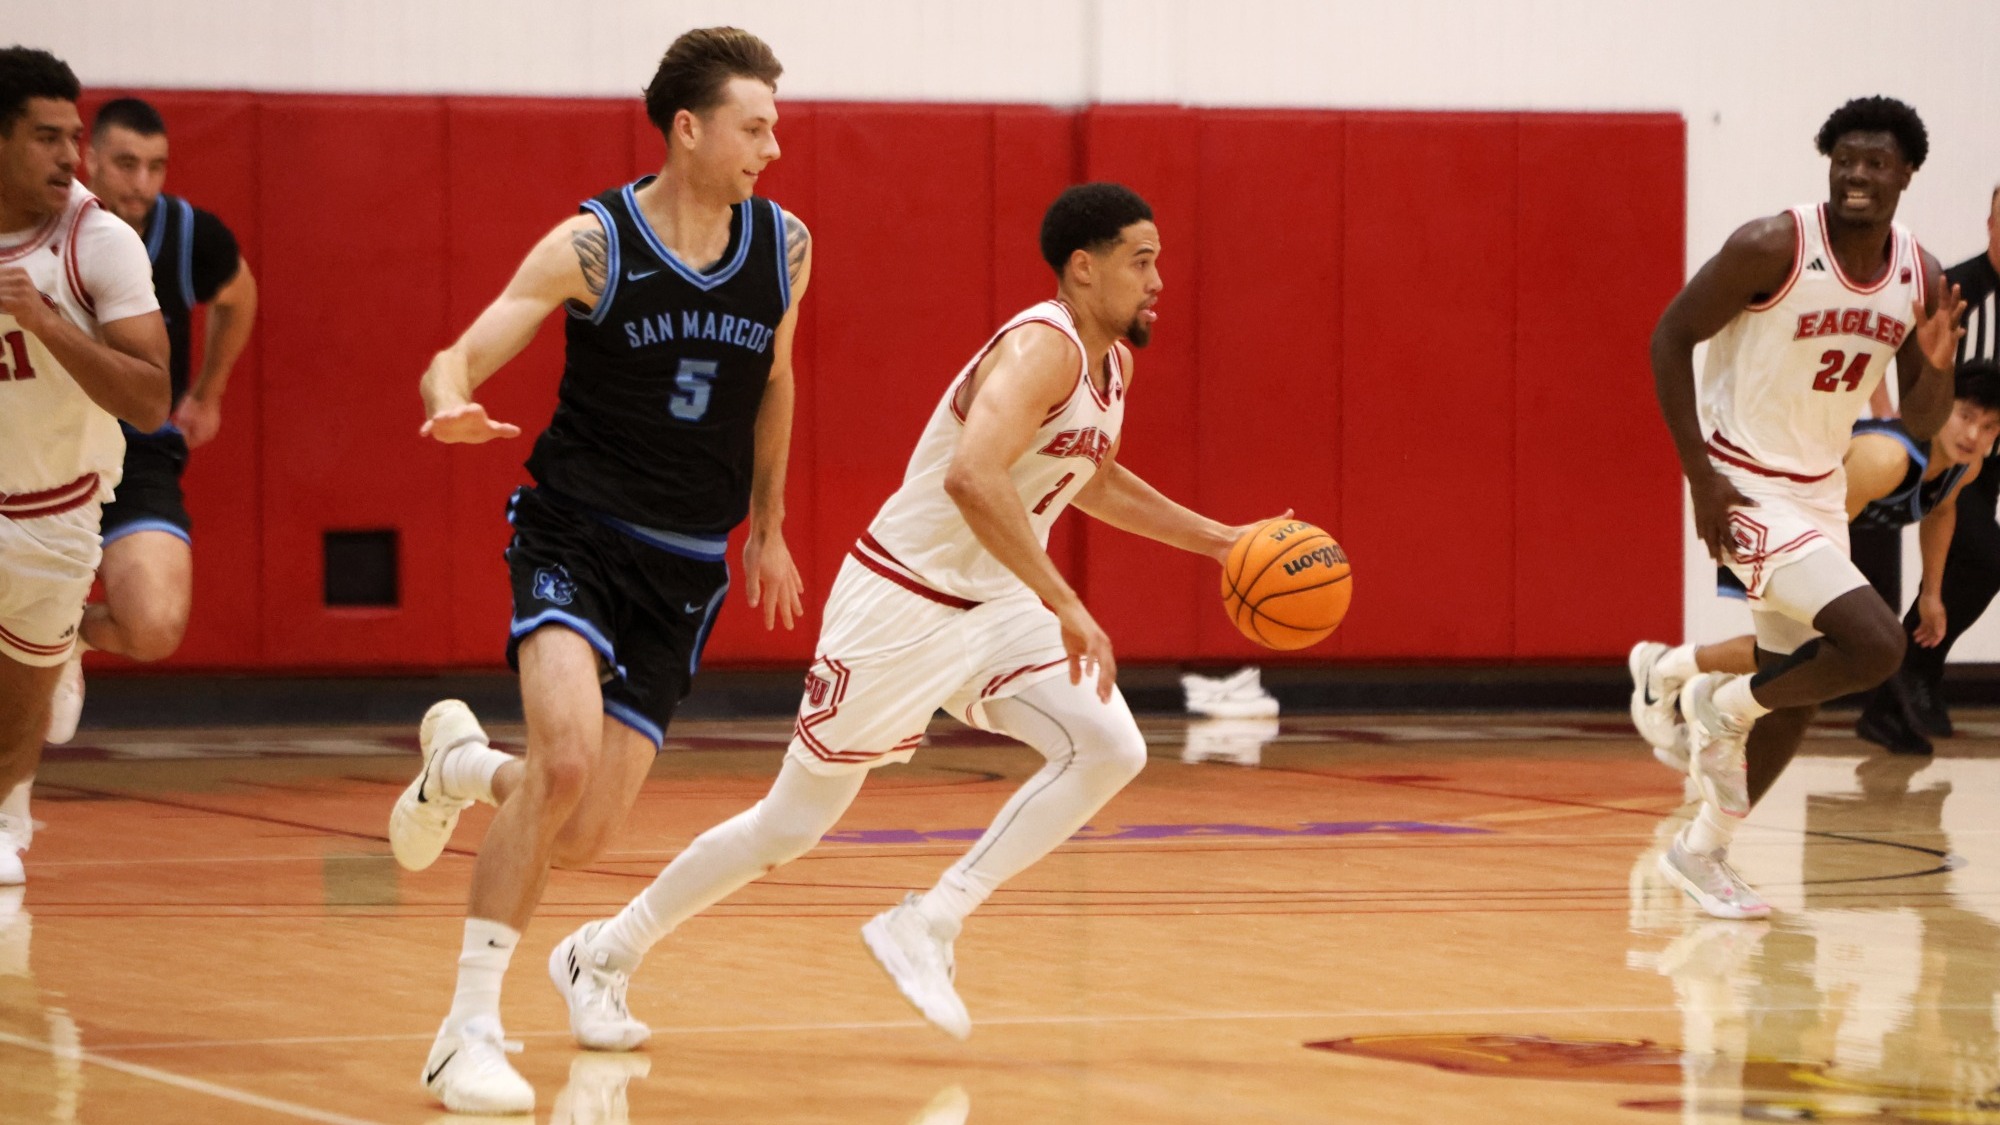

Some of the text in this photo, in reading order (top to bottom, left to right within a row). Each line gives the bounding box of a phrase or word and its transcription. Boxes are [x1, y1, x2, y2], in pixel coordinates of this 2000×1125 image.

[624, 309, 774, 354] SAN MARCOS
[1793, 306, 1907, 350] EAGLES
[668, 357, 719, 422] 5
[1811, 349, 1872, 393] 24
[1036, 426, 1112, 469] EAGLE
[1031, 471, 1076, 516] 2
[1269, 521, 1311, 542] CAA
